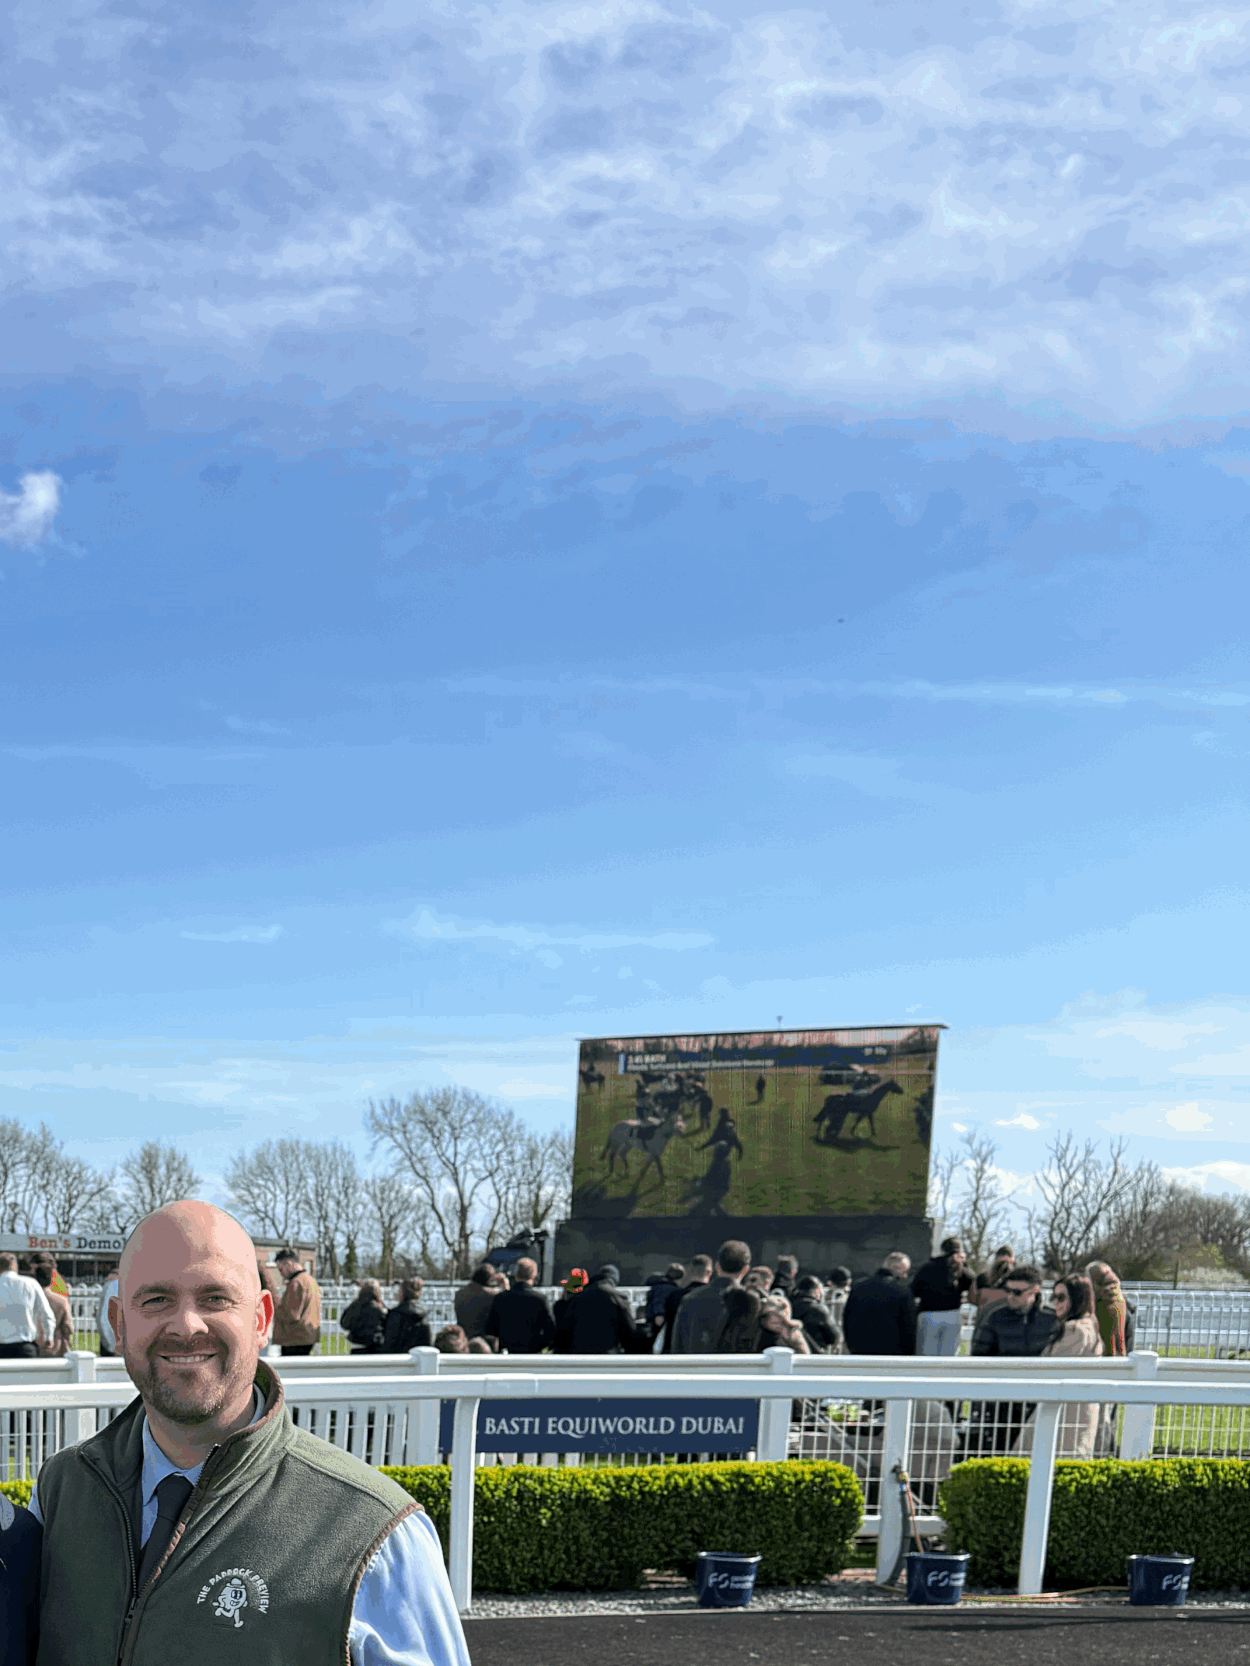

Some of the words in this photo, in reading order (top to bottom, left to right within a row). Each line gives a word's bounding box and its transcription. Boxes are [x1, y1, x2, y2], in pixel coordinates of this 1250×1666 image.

[28, 1236, 71, 1249] Ben's
[484, 1416, 540, 1435] BASTI
[547, 1416, 675, 1439] EQUIWORLD
[681, 1416, 745, 1435] DUBAI
[197, 1585, 210, 1604] THE
[209, 1567, 253, 1586] PADDOCK
[250, 1574, 270, 1614] PREVIEW
